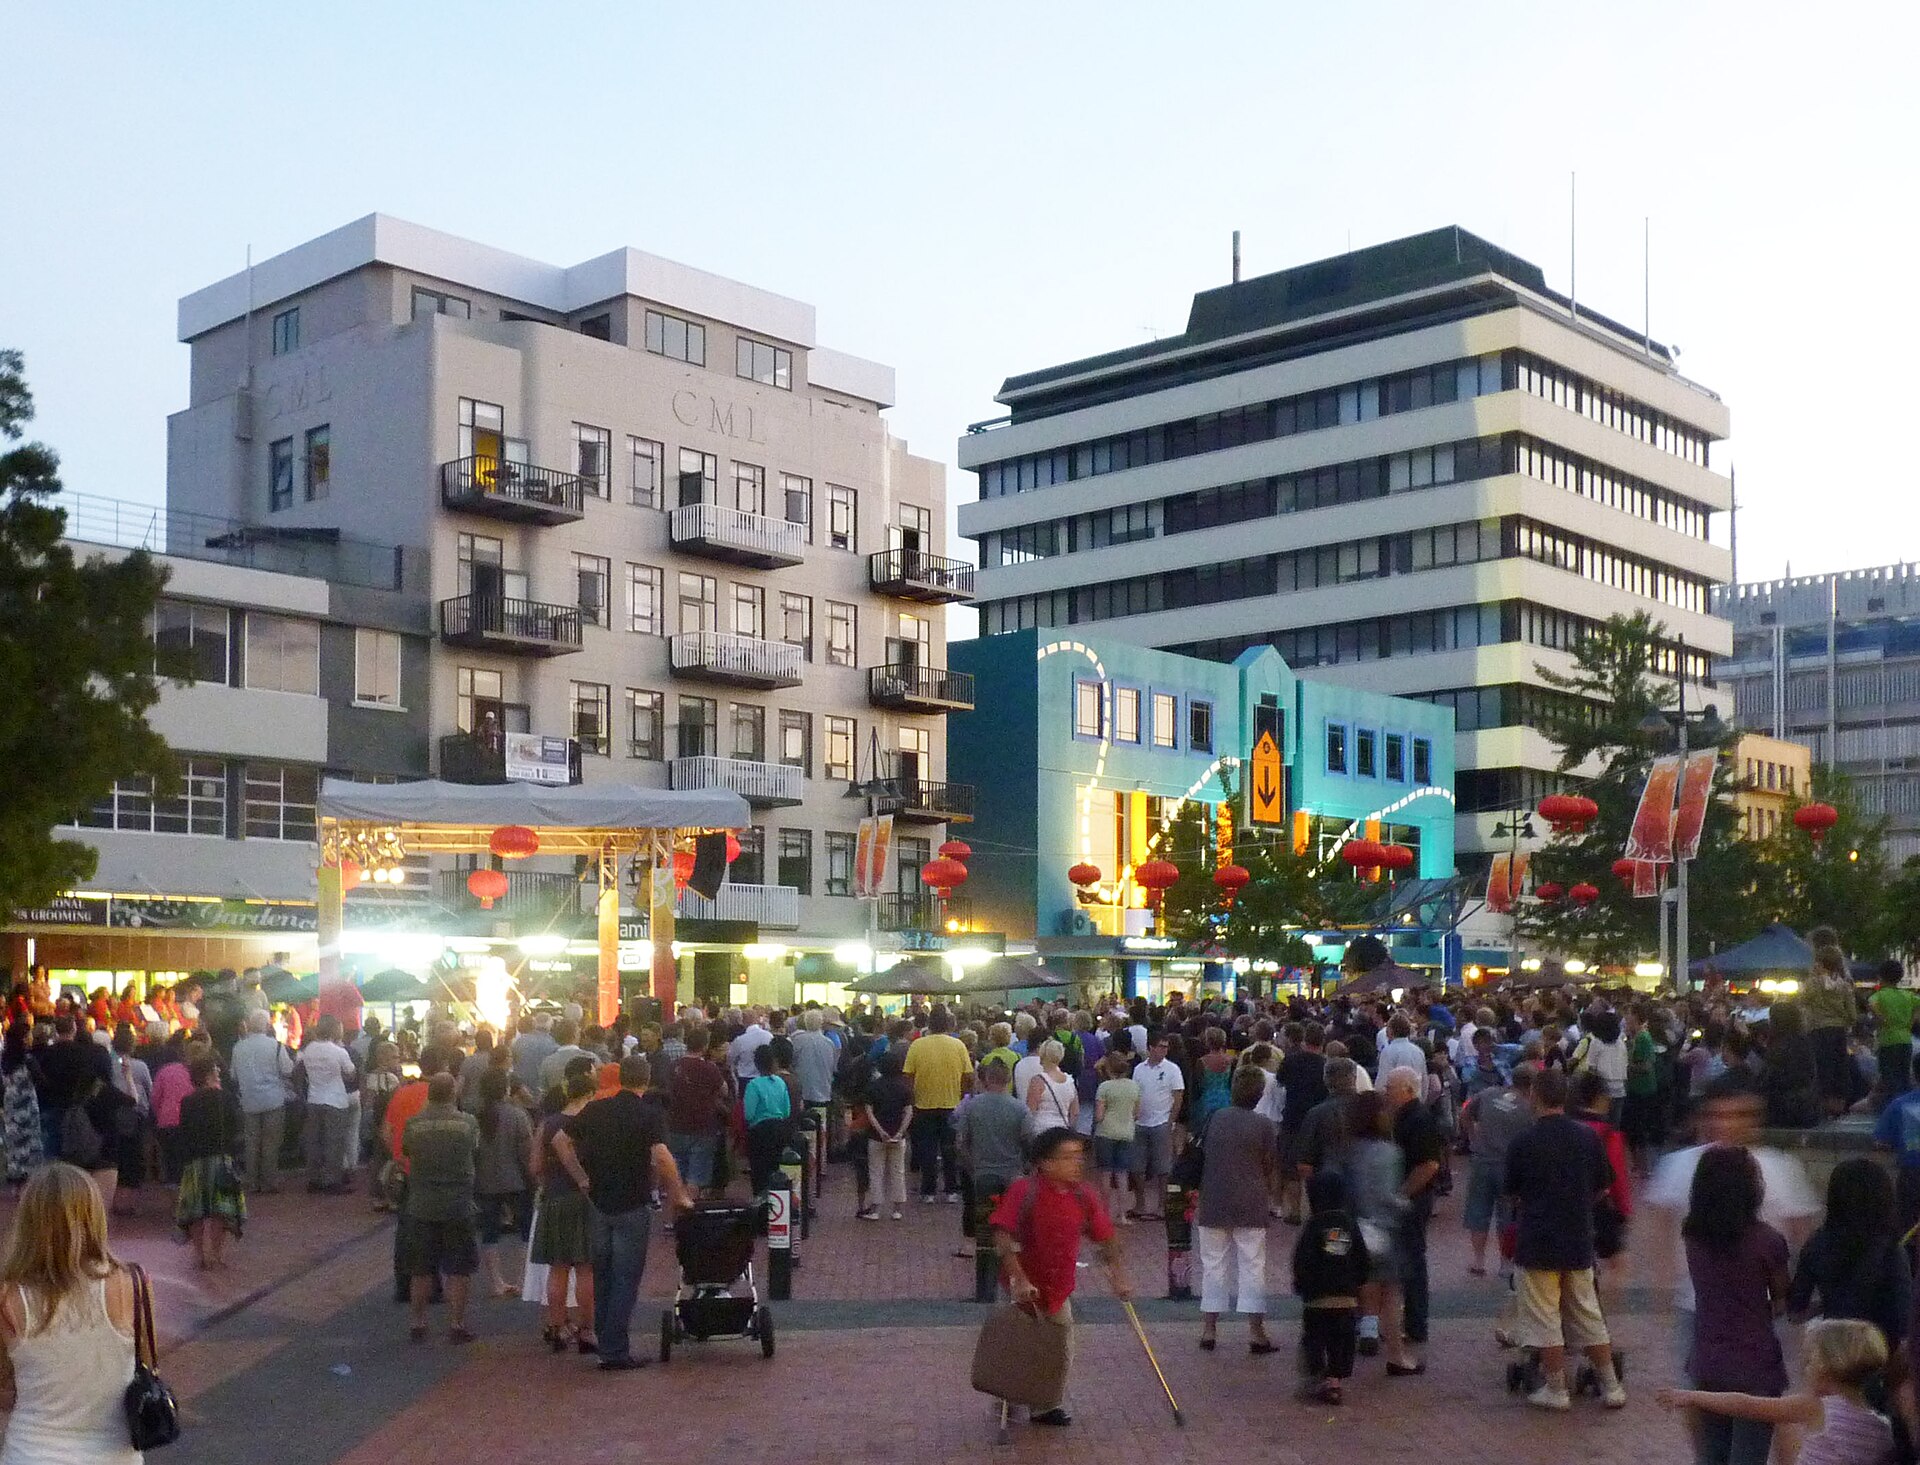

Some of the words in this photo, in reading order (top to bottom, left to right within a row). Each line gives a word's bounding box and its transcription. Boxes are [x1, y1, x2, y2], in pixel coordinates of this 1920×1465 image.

[672, 389, 766, 445] CML
[30, 909, 92, 922] GROOMING
[619, 919, 648, 938] ami
